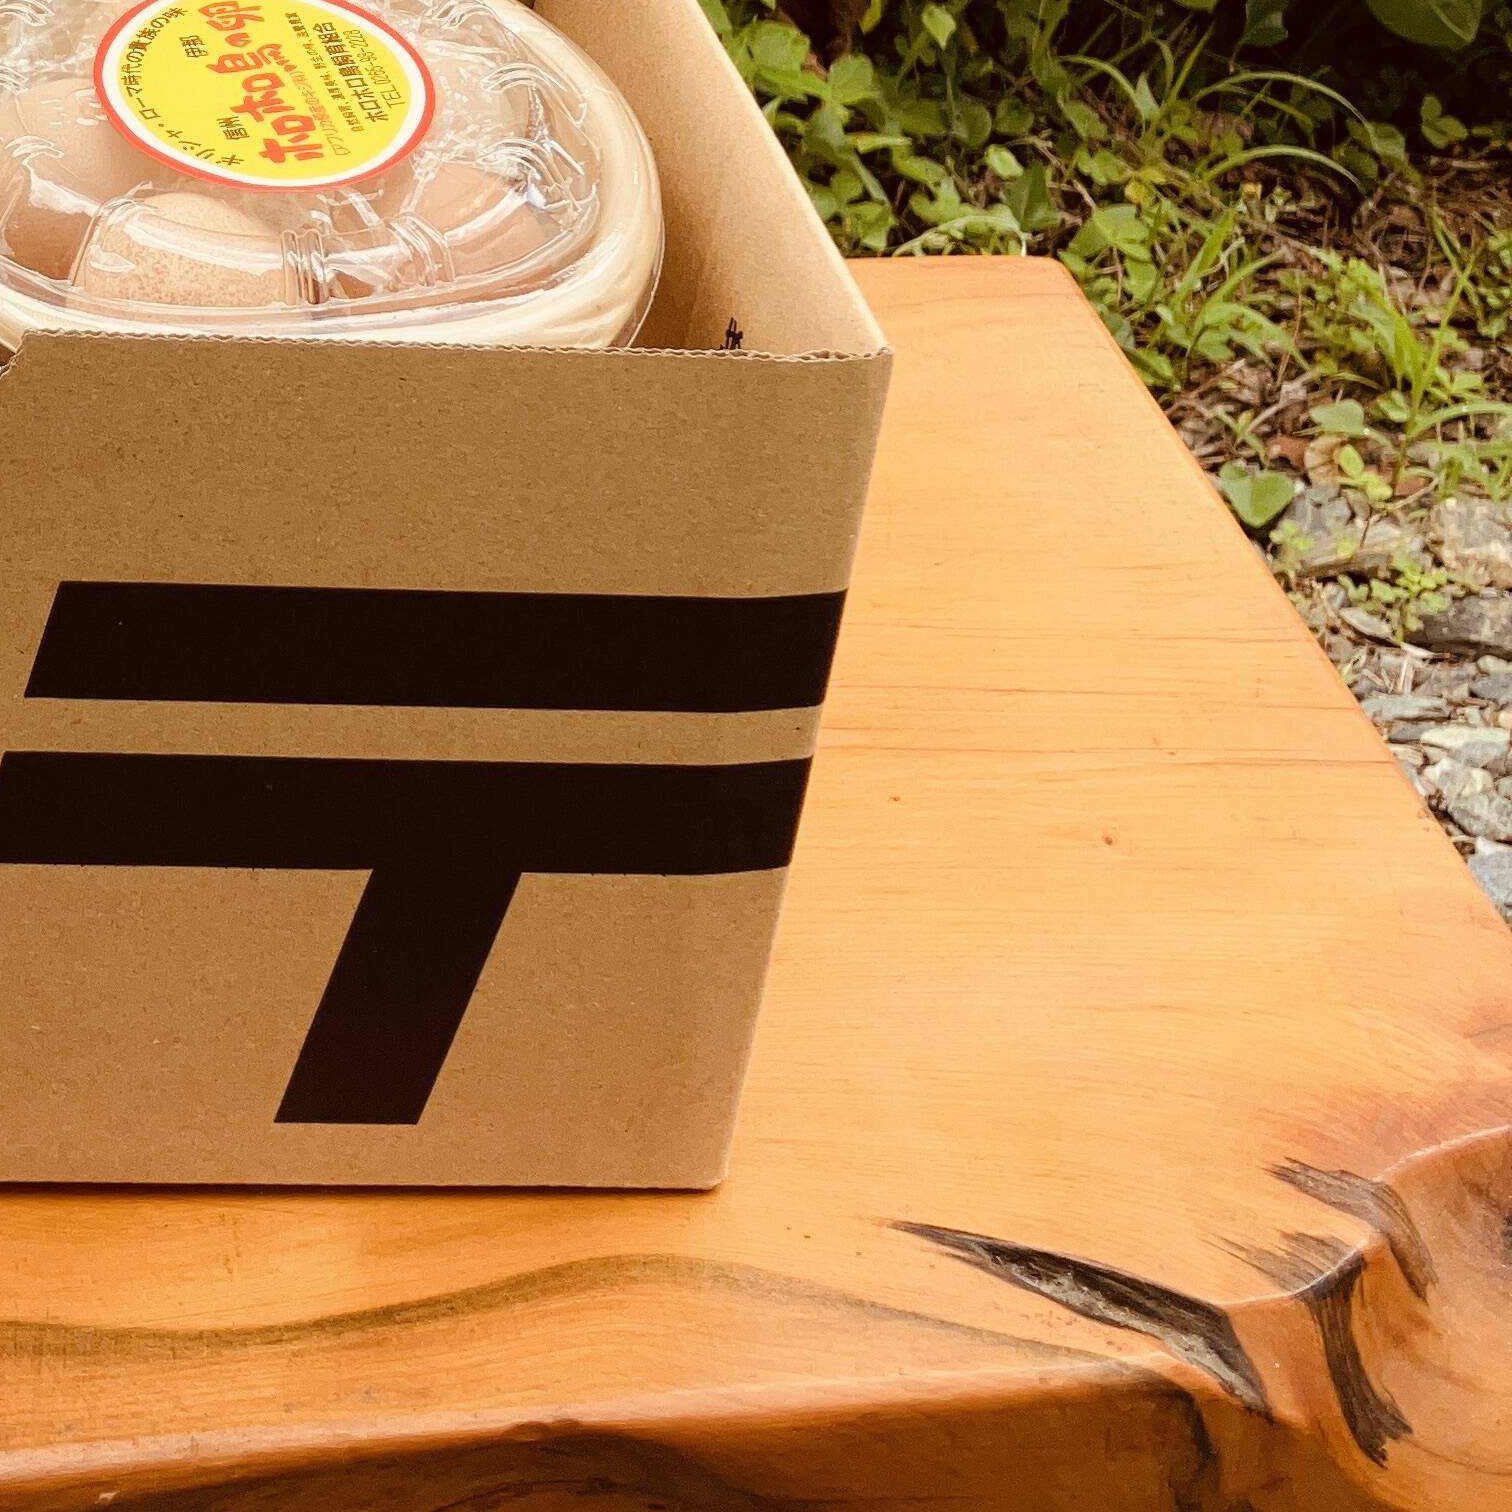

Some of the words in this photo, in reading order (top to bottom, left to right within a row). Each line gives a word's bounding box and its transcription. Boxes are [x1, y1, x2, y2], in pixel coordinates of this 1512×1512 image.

[179, 35, 209, 58] 伊那
[197, 0, 325, 164] ホロホロ鳥の卵
[216, 116, 250, 140] 信州
